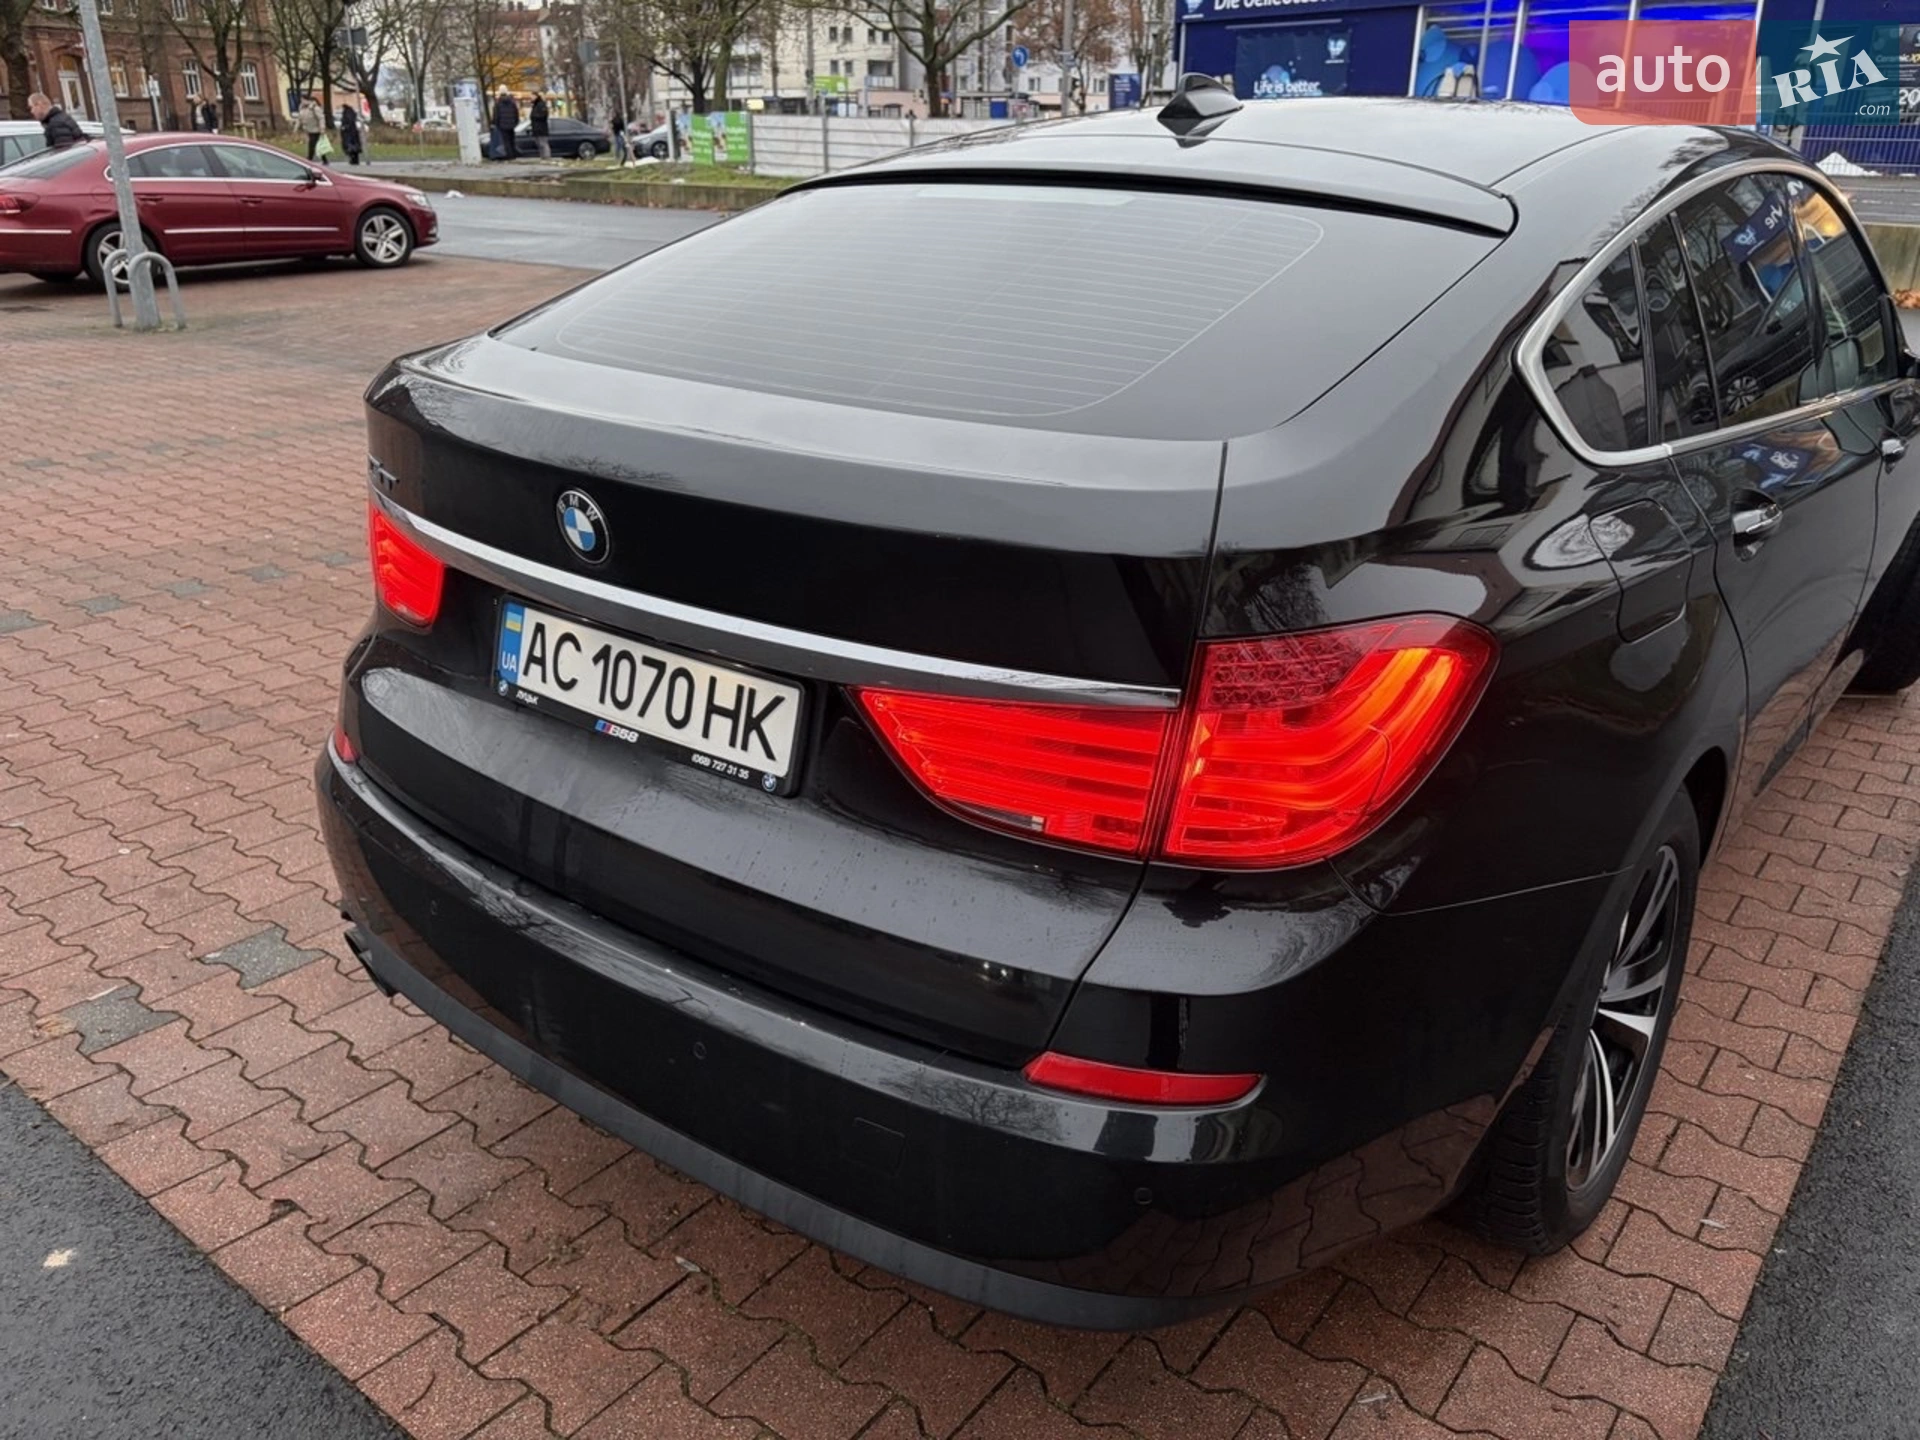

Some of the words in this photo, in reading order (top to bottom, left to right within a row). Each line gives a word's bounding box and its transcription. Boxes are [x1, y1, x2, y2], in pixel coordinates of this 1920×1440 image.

[1253, 79, 1273, 94] Life
[1274, 80, 1284, 93] is
[557, 494, 599, 521] BMW
[502, 651, 517, 673] UA
[523, 622, 582, 691] AC
[592, 644, 695, 730] 1070
[702, 675, 786, 762] HK
